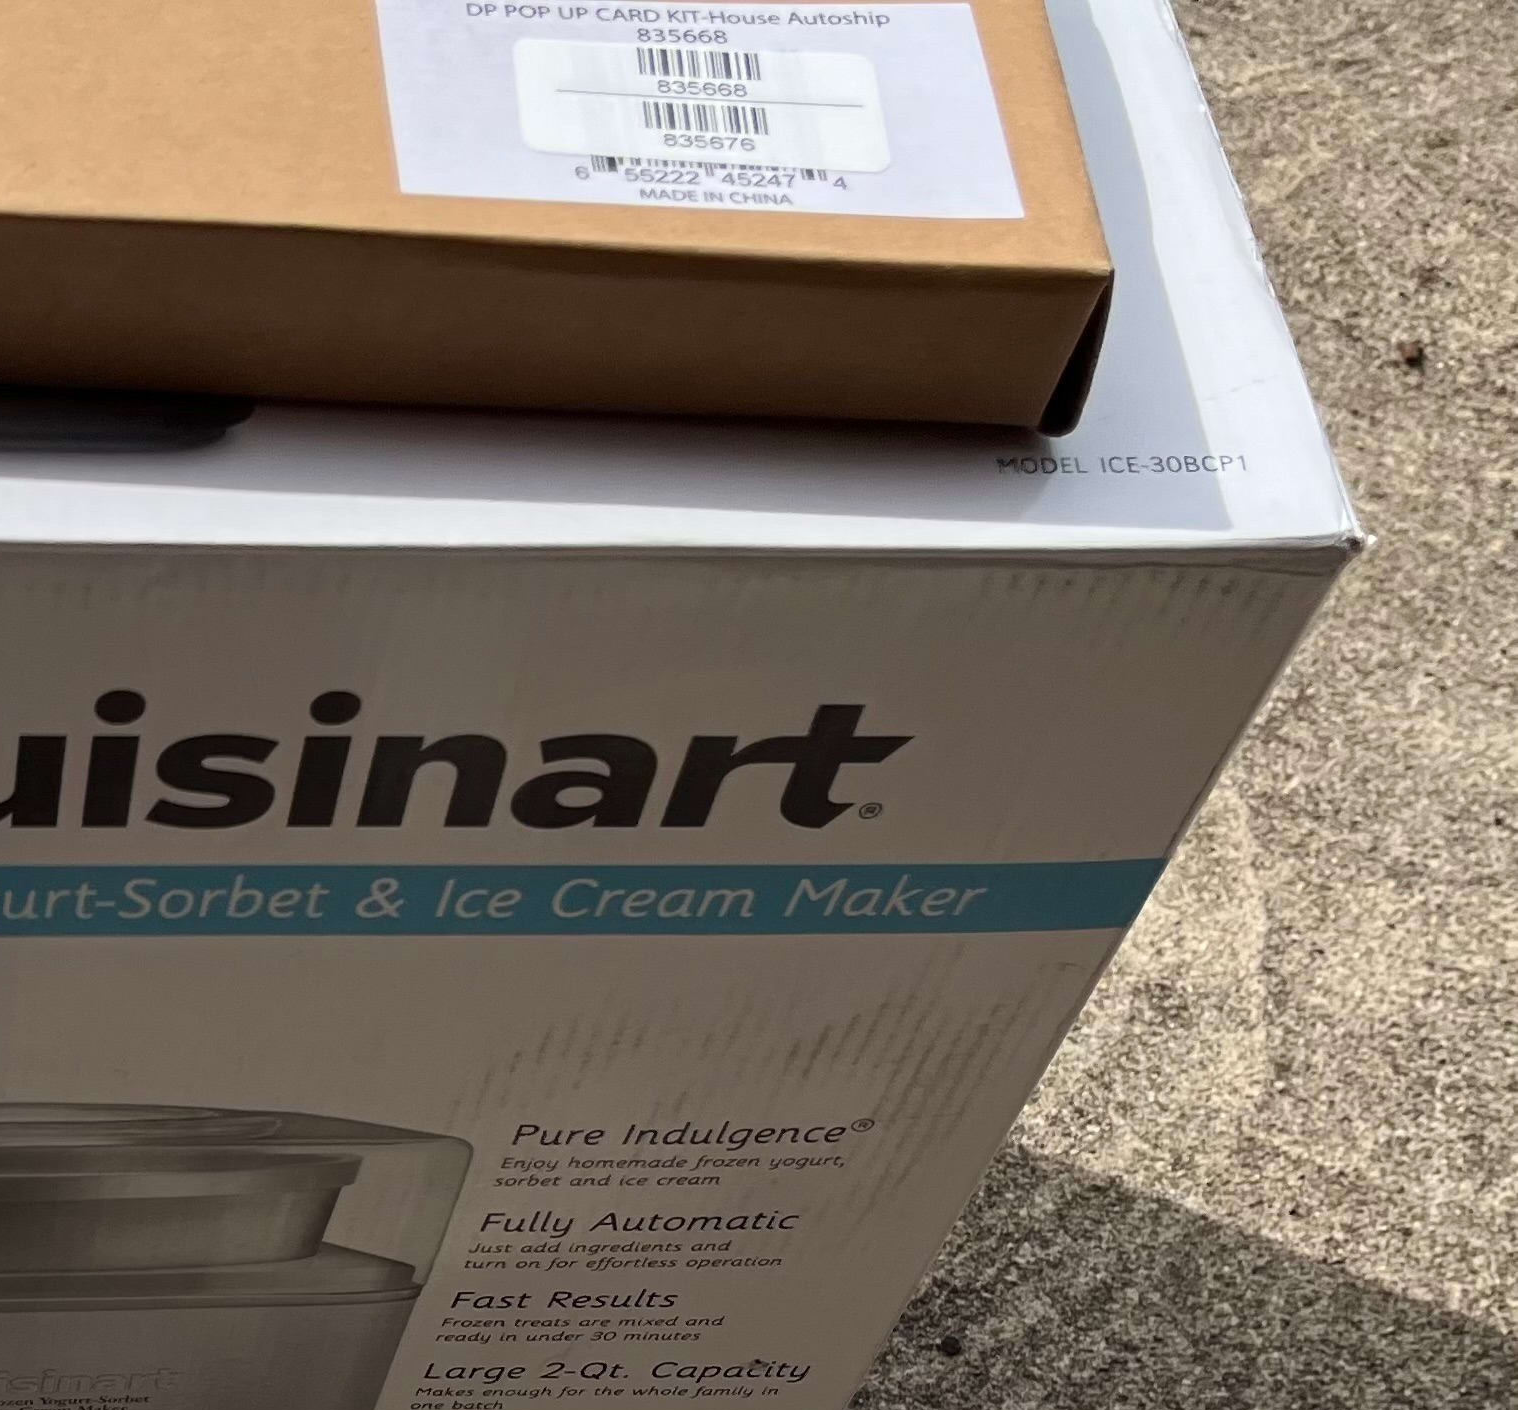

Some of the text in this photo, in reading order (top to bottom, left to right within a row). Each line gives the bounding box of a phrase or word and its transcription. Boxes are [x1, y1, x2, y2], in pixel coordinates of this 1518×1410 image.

[465, 3, 891, 28] DP POP UP CARD KIT-House Autoship
[636, 28, 728, 44] 835668
[656, 79, 749, 98] 835668
[663, 133, 757, 152] 835676
[574, 166, 848, 191] 6 55222 45247 4
[639, 188, 794, 205] MADE IN CHINA
[995, 454, 1248, 475] MODEL ICE-30BCP1
[354, 876, 406, 919] &
[435, 878, 524, 919] Ice
[550, 877, 756, 919] Cream
[784, 873, 989, 919] Maker
[511, 1120, 848, 1152] Pure Indulgence
[499, 1154, 847, 1173] Enjoy homemade frozen yogurt,
[492, 1174, 721, 1188] sorbet and ice cream
[479, 1210, 803, 1239] Fully Automatic
[467, 1239, 733, 1257] Just add ingredients and
[463, 1255, 783, 1272] turn on for effortless operation
[449, 1288, 680, 1310] Fast Results
[440, 1314, 728, 1329] Frozen treats are mixed and
[434, 1329, 701, 1345] ready in under 30 minutes
[421, 1360, 813, 1385] Large 2-Qt. Capacity
[414, 1384, 780, 1400] Makes enough for the whole family in
[409, 1399, 505, 1410] one batch
